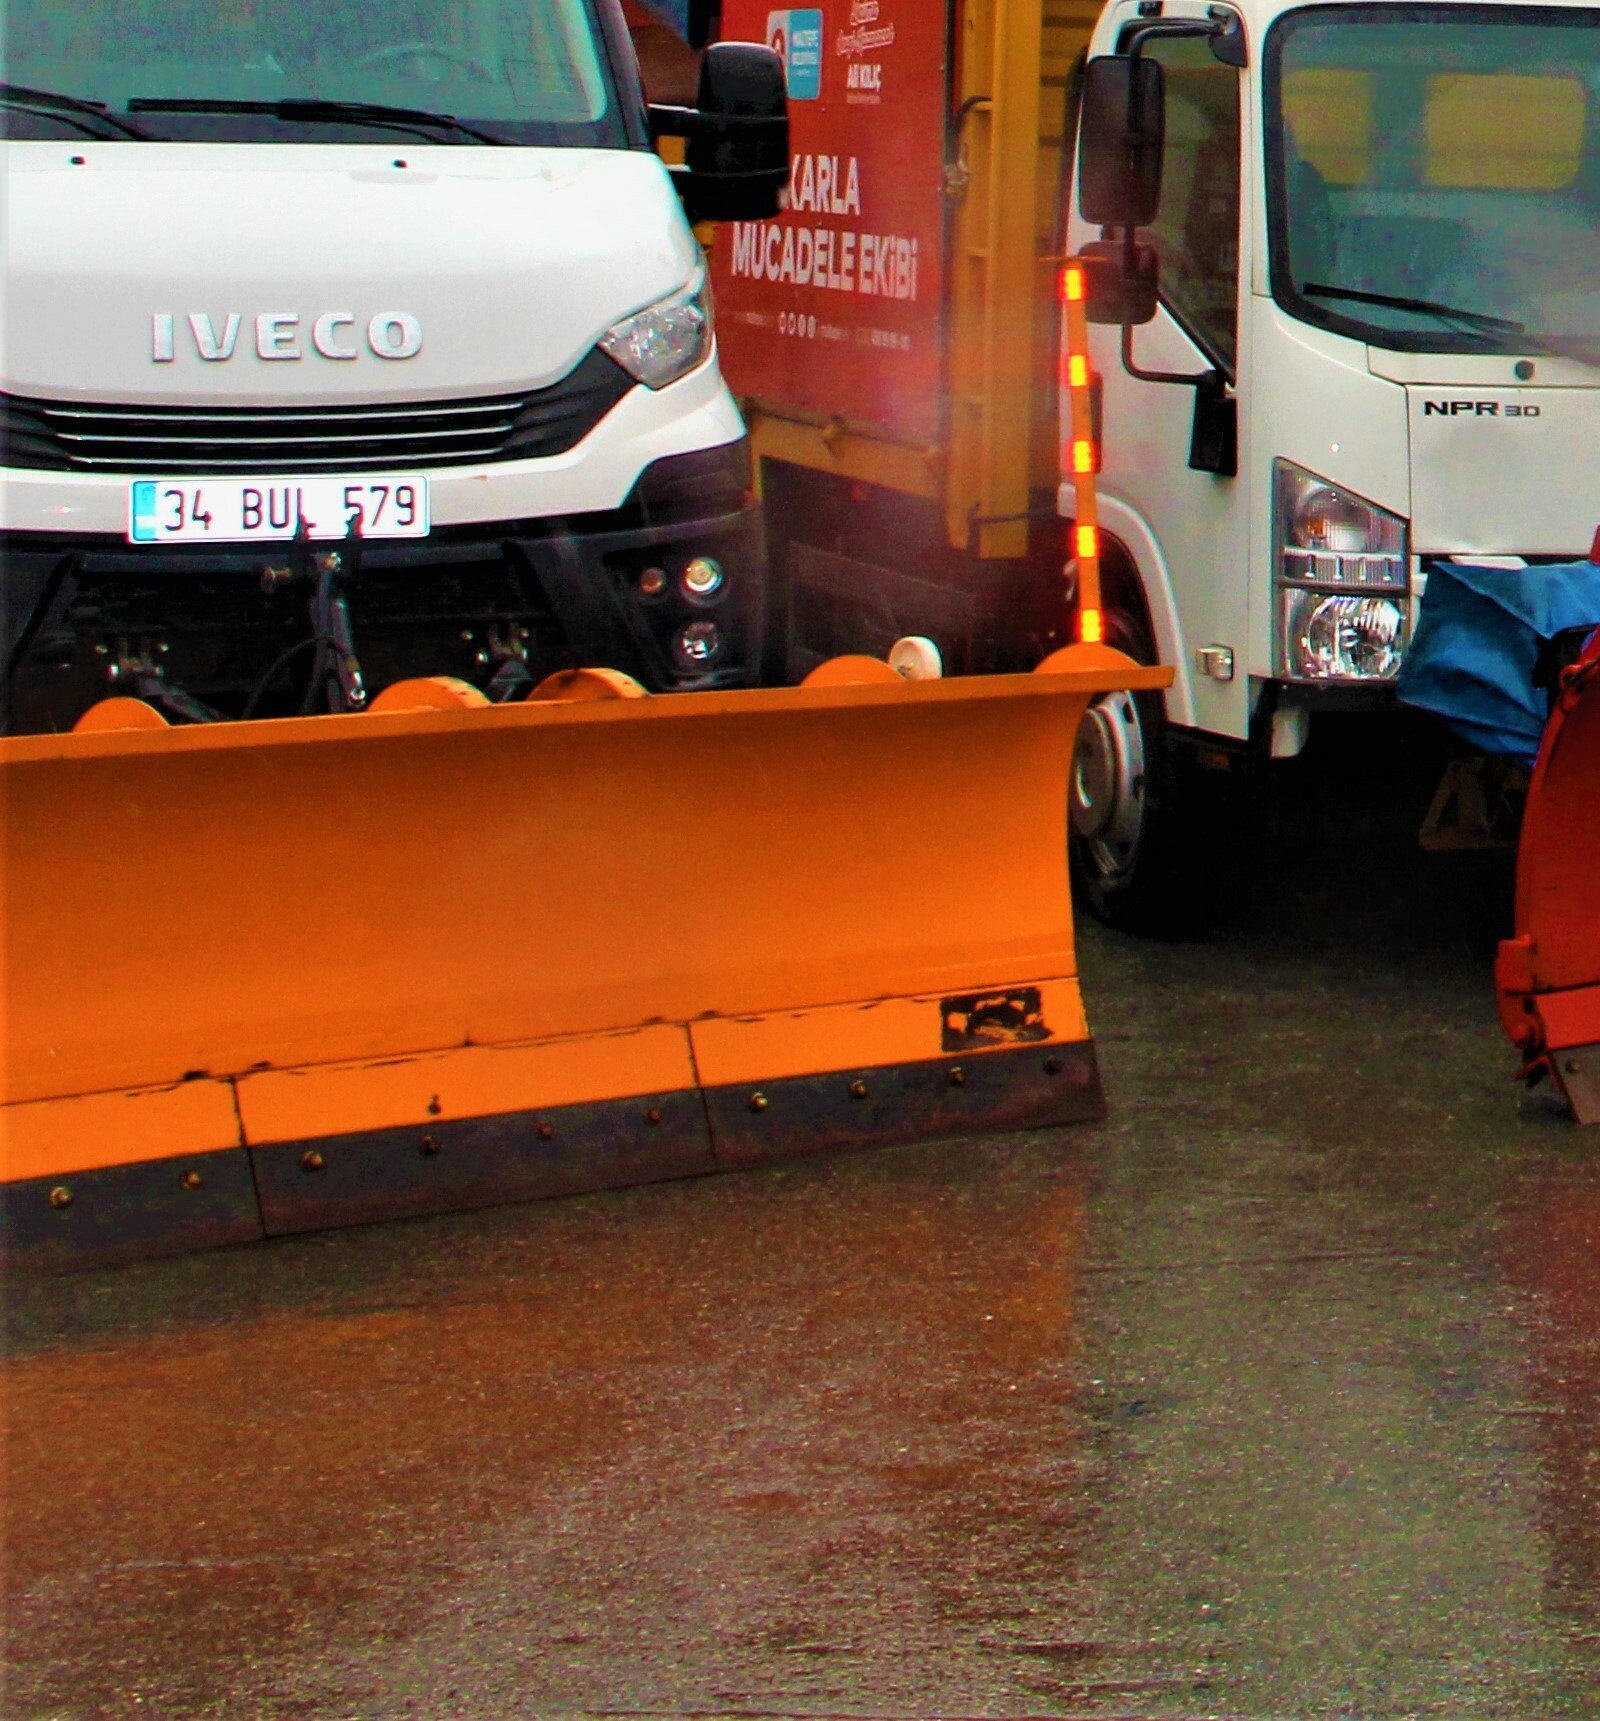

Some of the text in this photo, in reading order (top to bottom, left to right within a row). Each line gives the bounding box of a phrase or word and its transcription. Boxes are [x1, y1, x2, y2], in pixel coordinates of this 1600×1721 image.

[731, 220, 918, 301] MÜCADELE EKİBİ
[152, 312, 423, 362] IVECO
[1424, 401, 1540, 417] NPR 30
[163, 489, 213, 531] 34
[343, 485, 416, 532] 579
